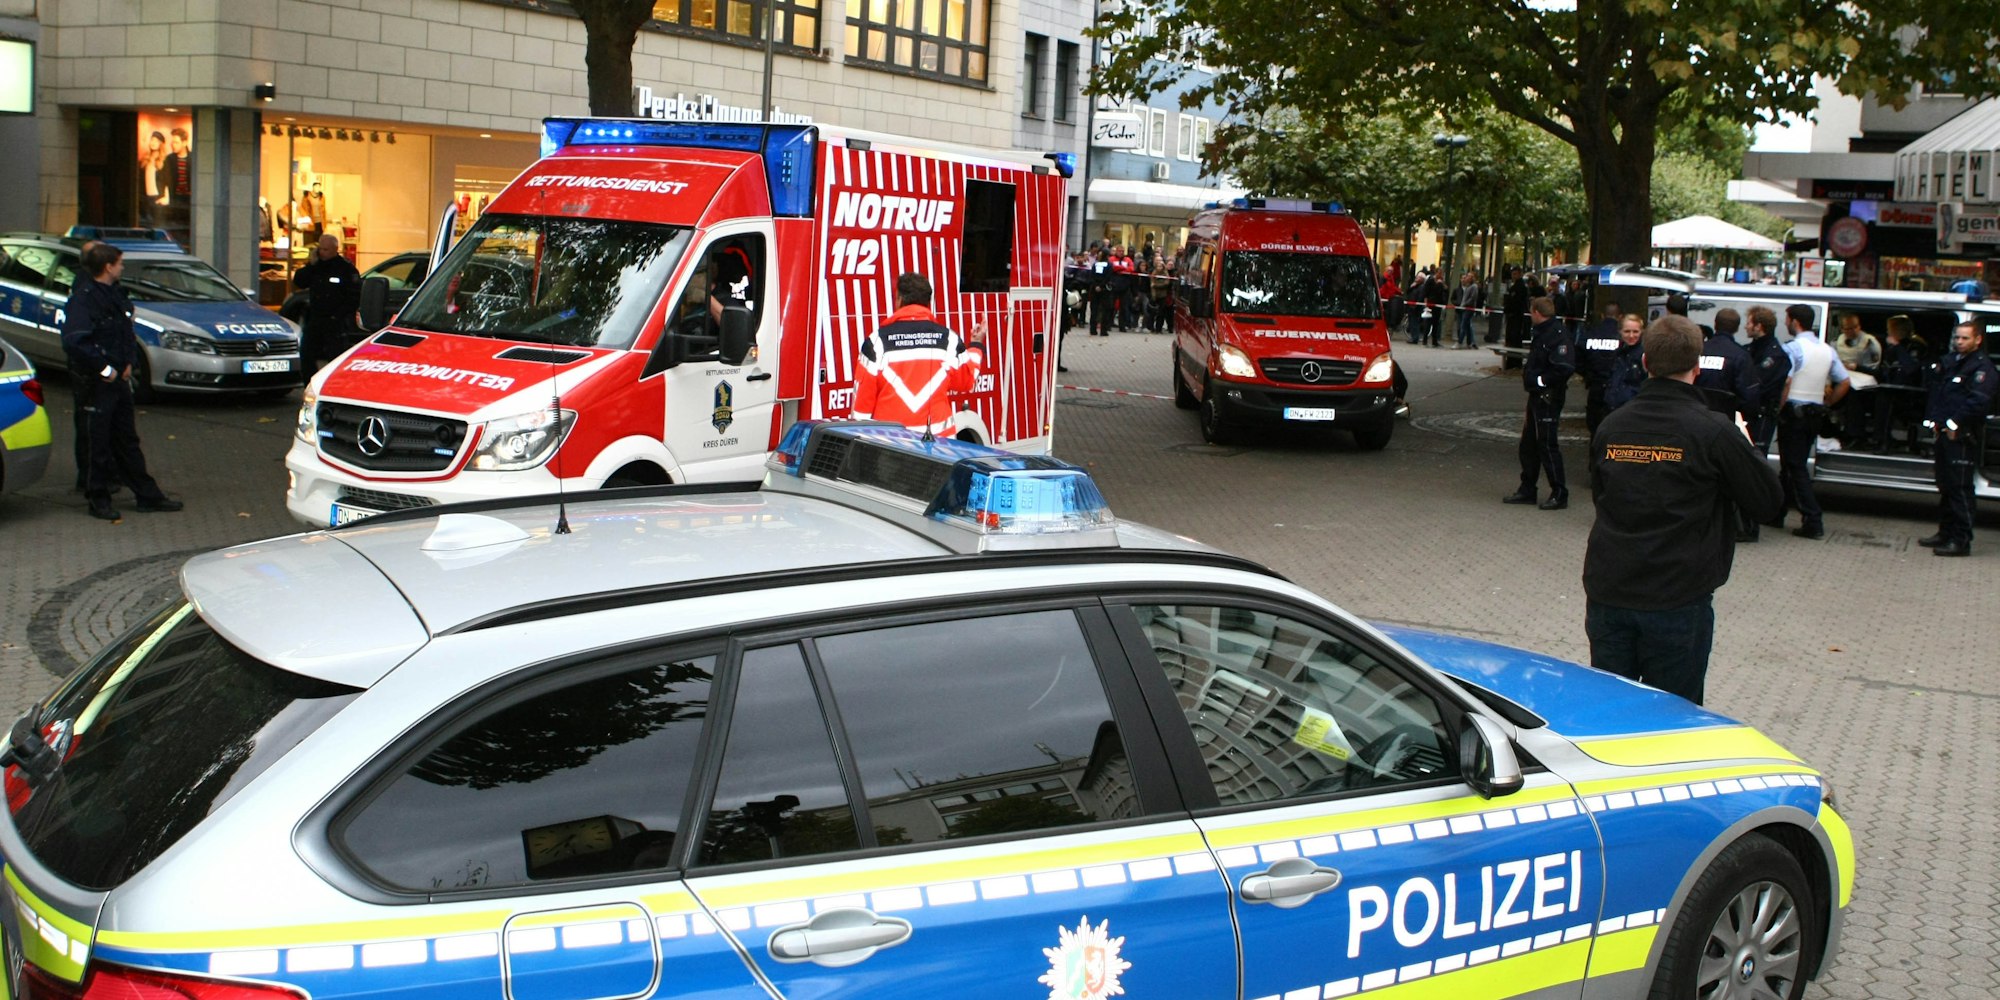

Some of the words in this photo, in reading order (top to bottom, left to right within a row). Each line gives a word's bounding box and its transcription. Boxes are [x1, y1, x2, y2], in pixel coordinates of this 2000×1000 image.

[525, 175, 688, 195] RETTUNGSDIENST
[833, 191, 954, 233] NOTRUF
[1261, 243, 1293, 251] DÜREN
[831, 238, 880, 275] 112
[215, 323, 287, 334] POLIZEI
[1255, 330, 1361, 341] FEUERWEHR
[703, 440, 718, 448] KREIS
[720, 437, 738, 446] DÜREN
[1347, 850, 1581, 958] POLIZEI
